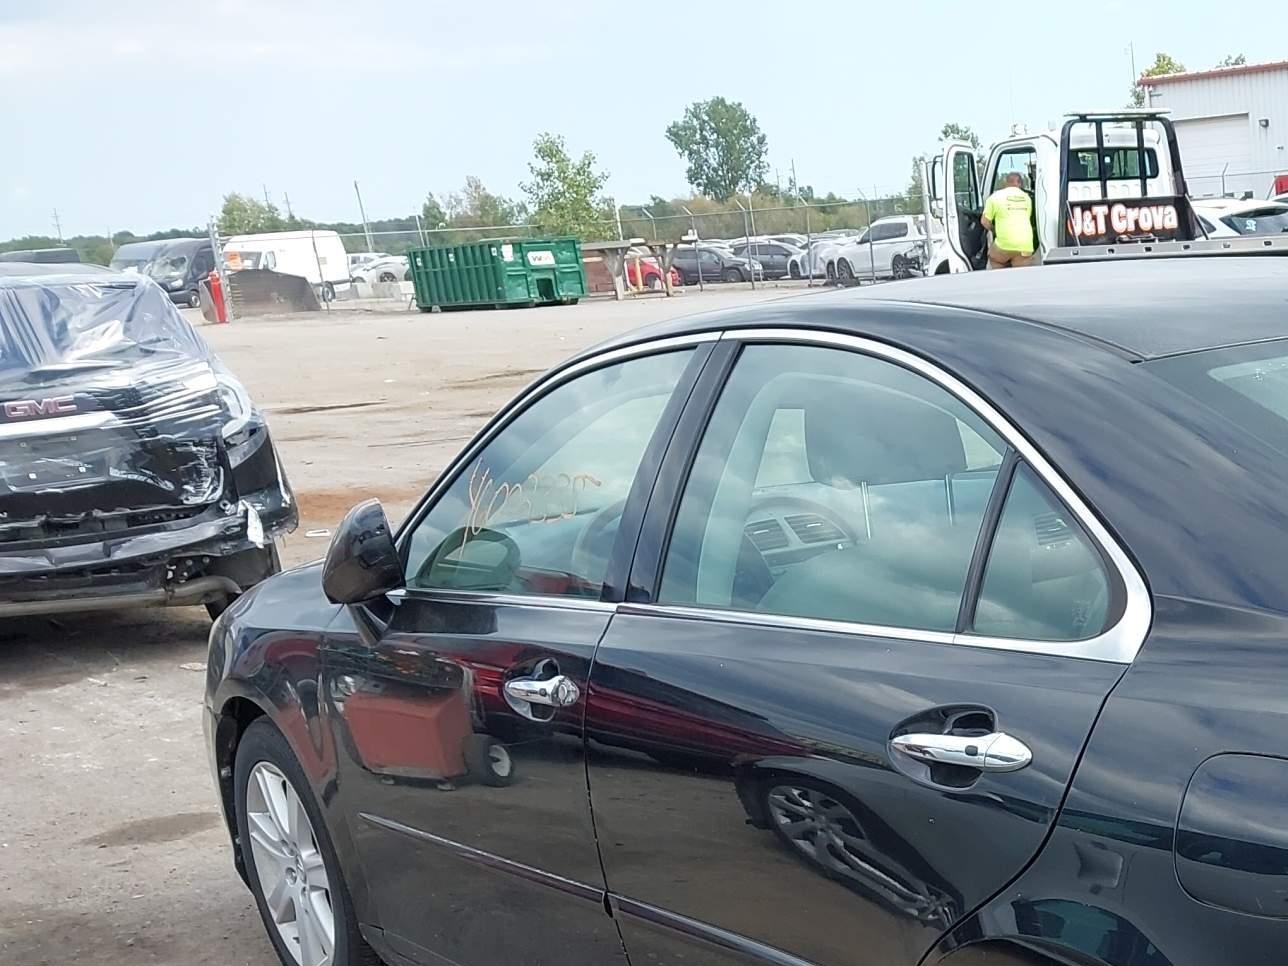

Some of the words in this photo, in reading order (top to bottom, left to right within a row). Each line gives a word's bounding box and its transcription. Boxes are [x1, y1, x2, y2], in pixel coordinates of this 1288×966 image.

[1067, 204, 1109, 236] J&T
[1110, 202, 1179, 233] Crova
[4, 395, 77, 417] GMC
